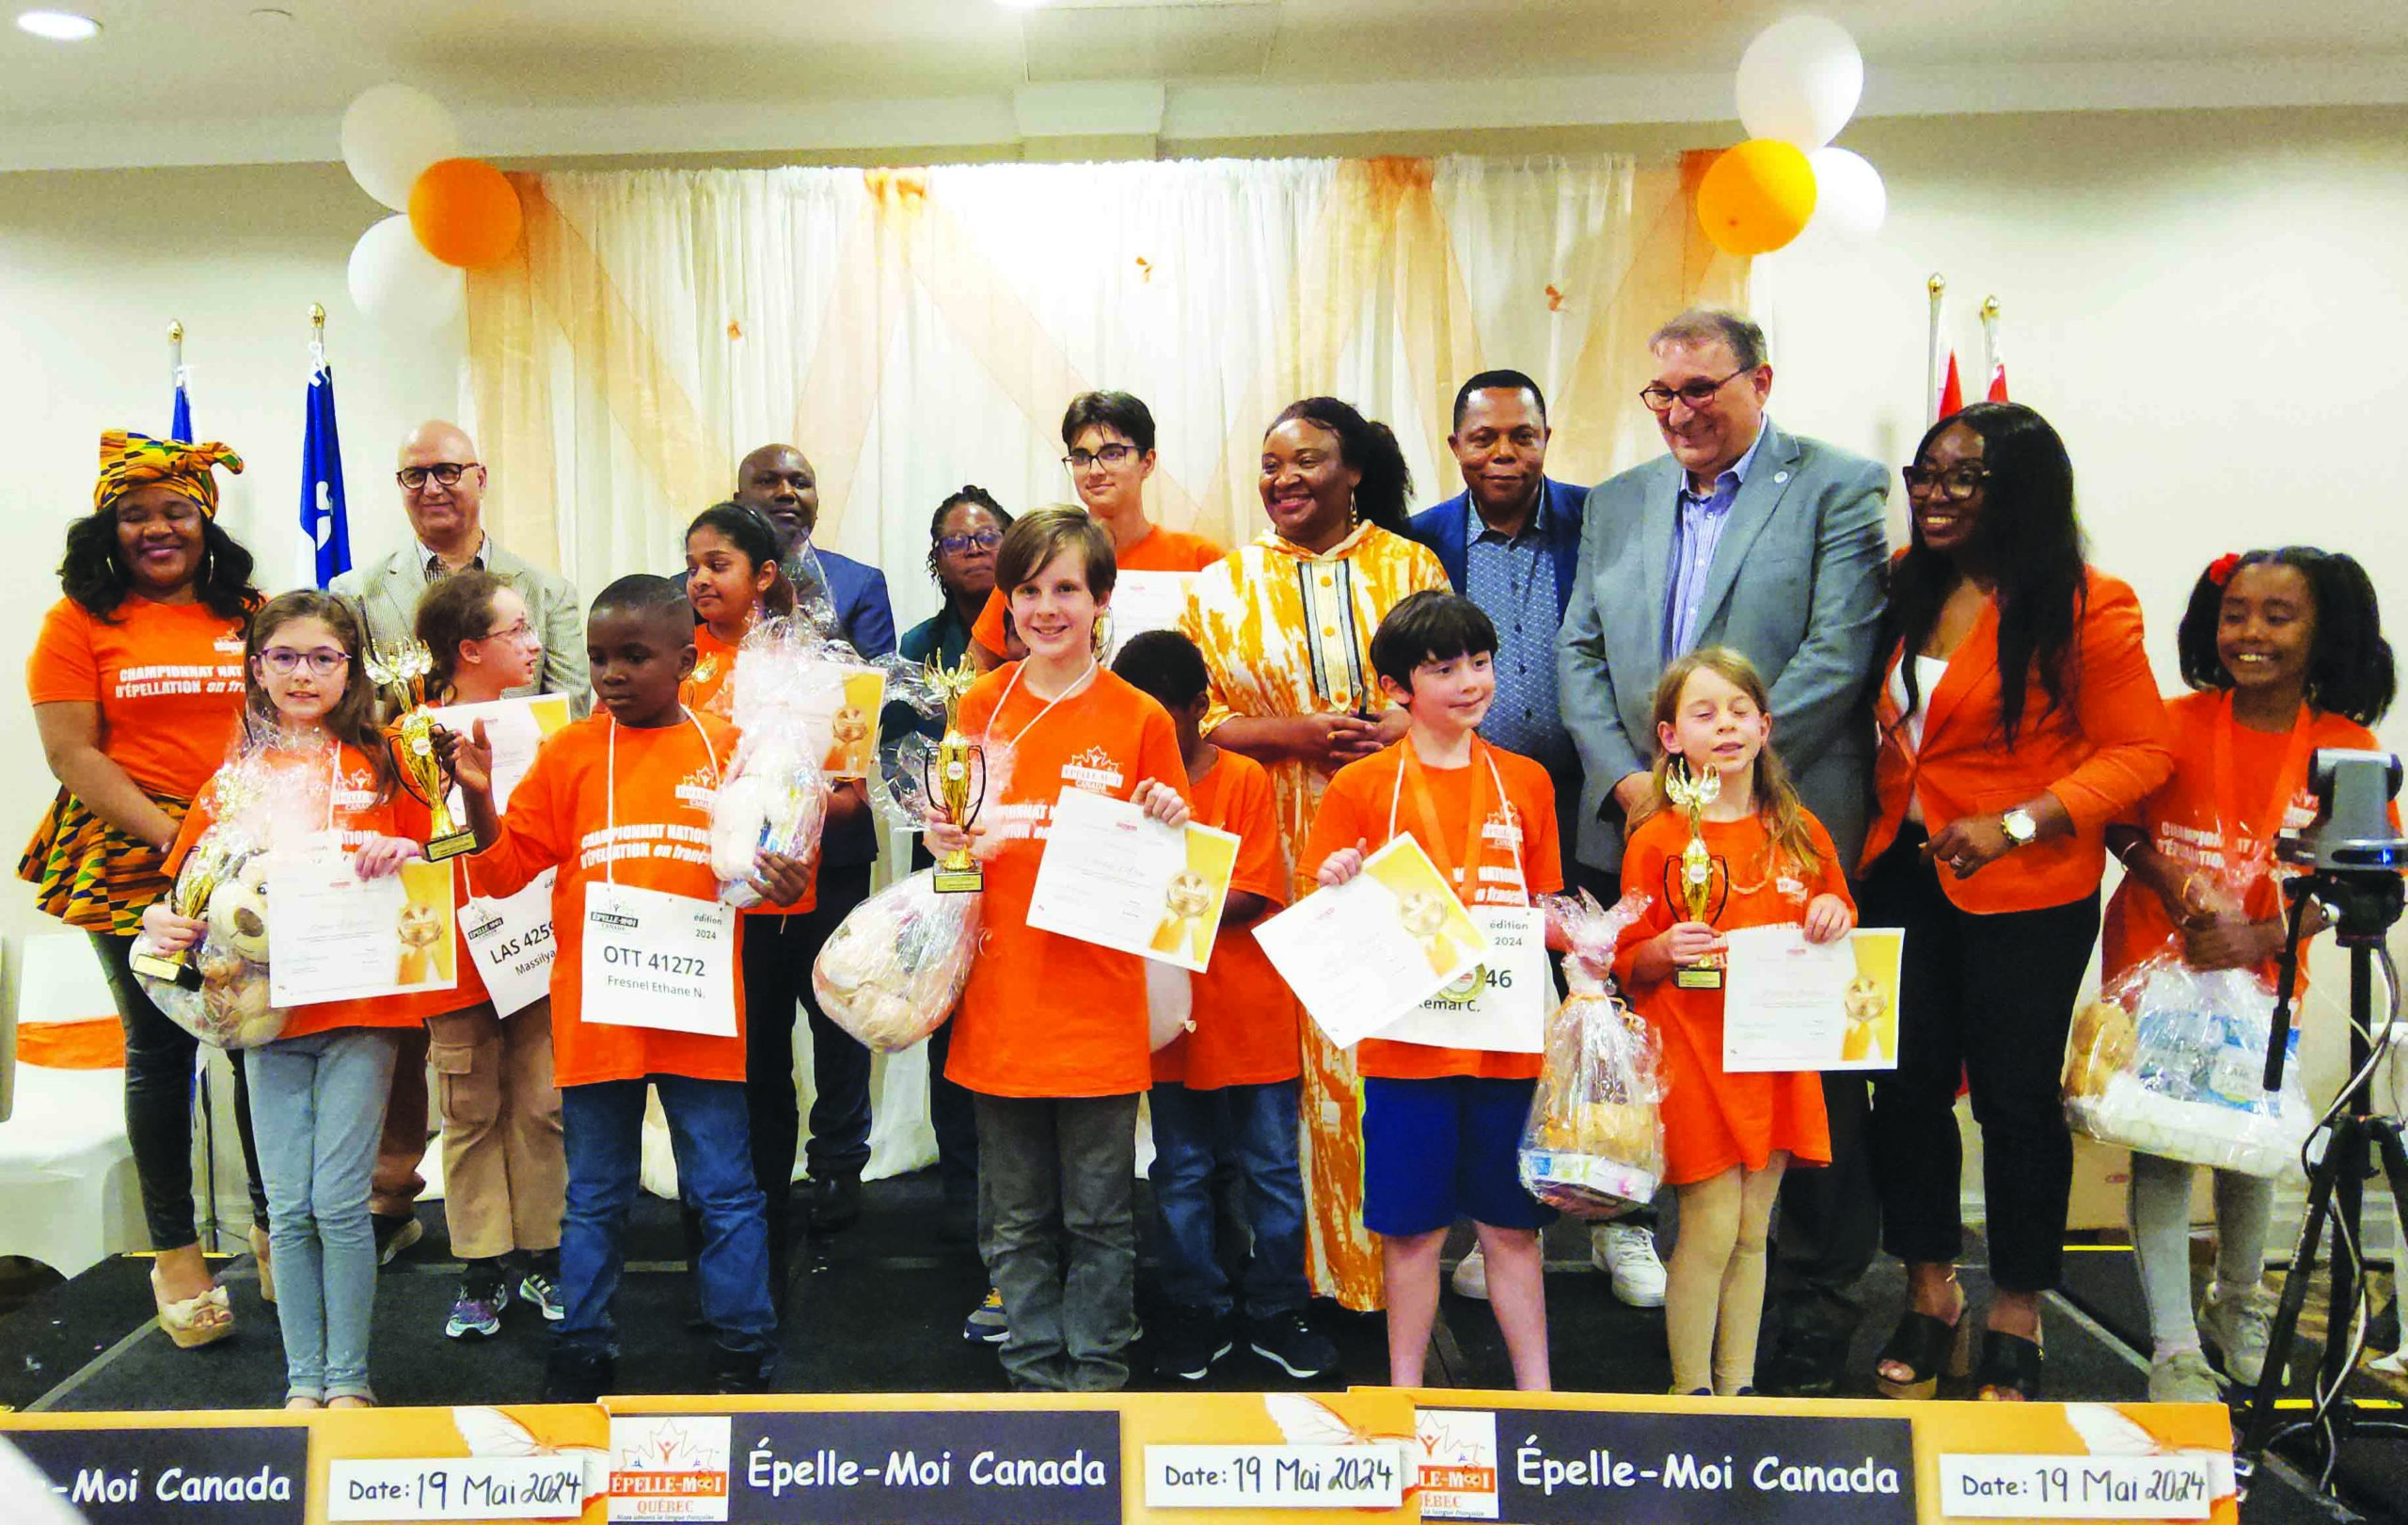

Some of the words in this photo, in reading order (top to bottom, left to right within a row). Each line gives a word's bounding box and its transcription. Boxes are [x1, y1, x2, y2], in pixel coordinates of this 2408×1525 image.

[217, 665, 244, 678] NAT
[228, 679, 246, 693] fra
[695, 929, 717, 940] 2024
[1495, 936, 1523, 946] 2024
[490, 938, 521, 964] LAS
[515, 949, 556, 976] Massilya
[603, 945, 642, 967] OTT
[648, 953, 706, 977] 41272
[608, 975, 649, 990] Fresnel
[652, 981, 690, 996] Ethane
[693, 987, 706, 999] N.
[1485, 969, 1513, 989] 46
[1419, 998, 1463, 1011] emal
[748, 1437, 952, 1497] Épelle-Moi
[969, 1450, 1106, 1486] Canada
[1165, 1465, 1228, 1486] Date:
[1233, 1456, 1261, 1493] 19
[1275, 1458, 1321, 1492] Mai
[1327, 1456, 1393, 1491] 2024
[1516, 1434, 1734, 1496] Épelle-Moi
[1752, 1455, 1900, 1494] Canada
[155, 1465, 291, 1502] Canada
[349, 1479, 410, 1501] Date:
[418, 1471, 448, 1510] 19
[464, 1474, 516, 1507] Mai
[520, 1471, 581, 1504] 2024
[1419, 1470, 1491, 1490] LE-MOI
[1962, 1474, 2028, 1496] Date:
[2036, 1468, 2067, 1502] 19
[2082, 1469, 2138, 1502] Mai
[2145, 1469, 2206, 1502] 2024
[637, 1498, 694, 1514] QUÉBEC
[1419, 1493, 1461, 1508] ÉBEC
